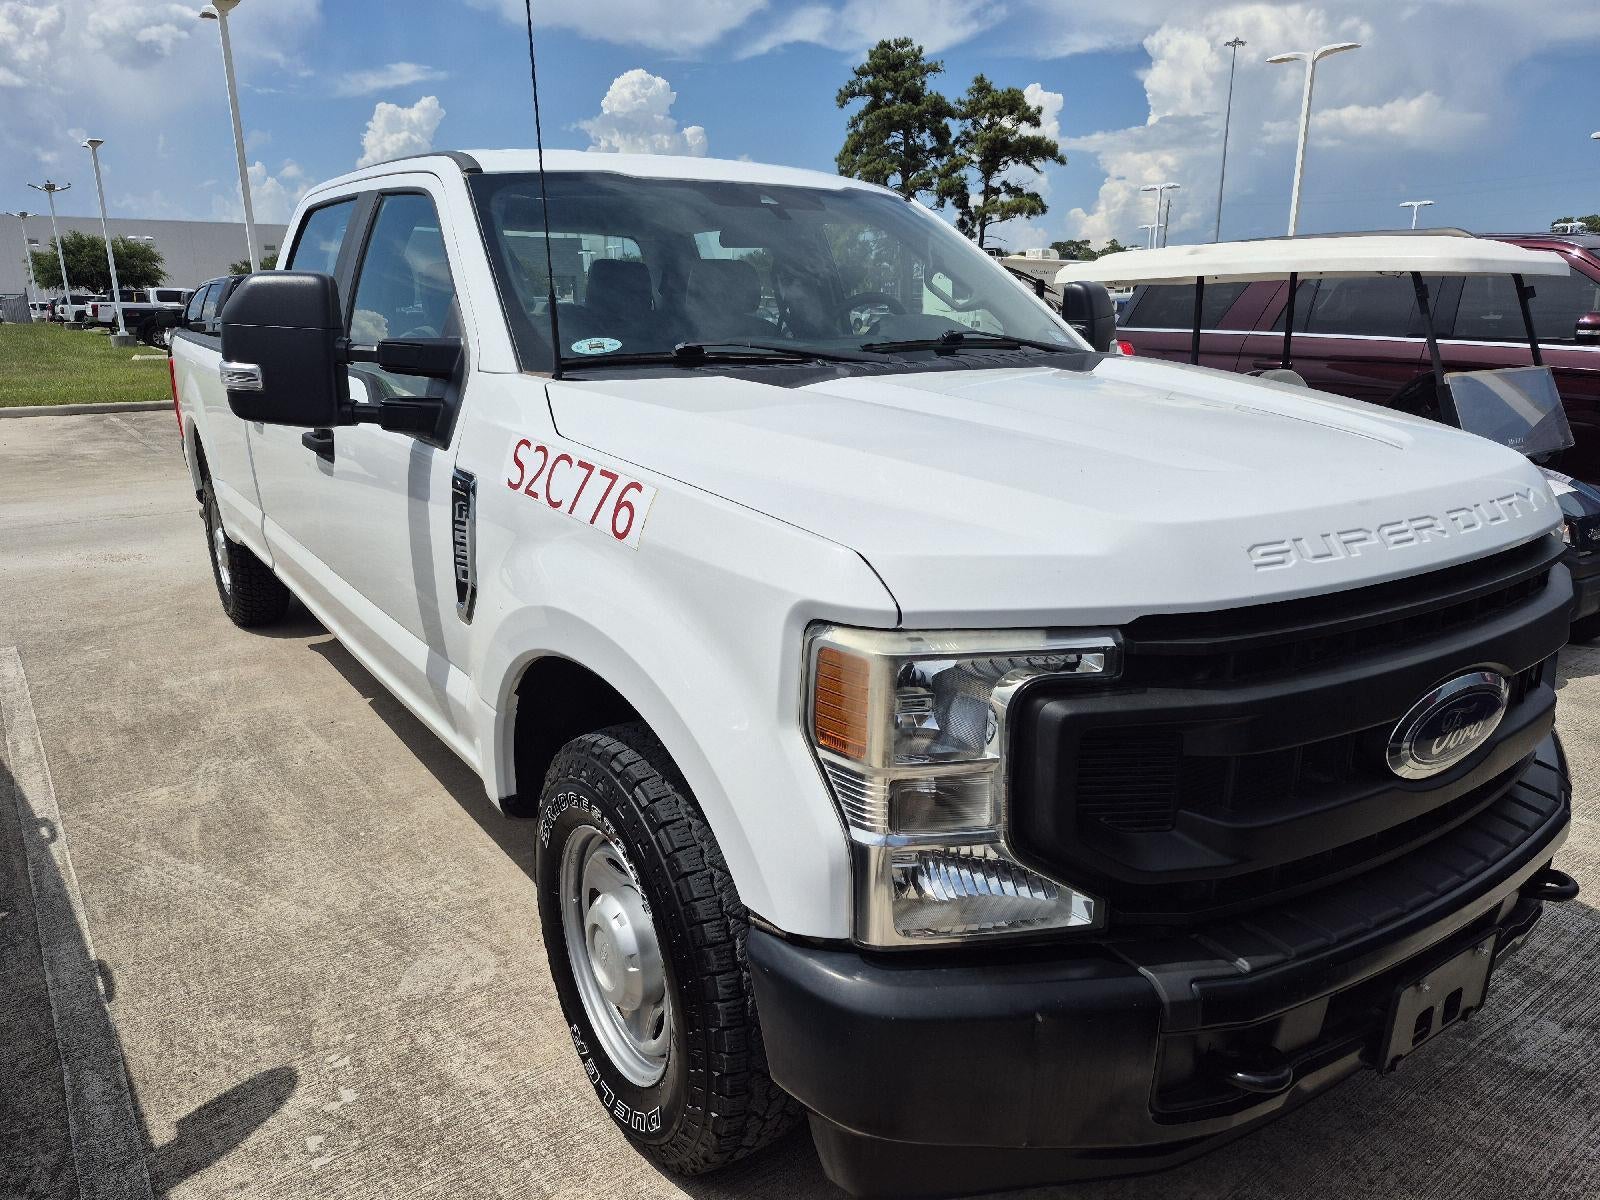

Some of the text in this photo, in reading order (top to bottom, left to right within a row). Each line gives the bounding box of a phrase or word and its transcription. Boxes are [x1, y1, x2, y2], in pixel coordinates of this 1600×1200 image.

[507, 438, 643, 540] S2C776
[1247, 488, 1539, 572] SUPER DUTY
[570, 1023, 661, 1132] DUELER
